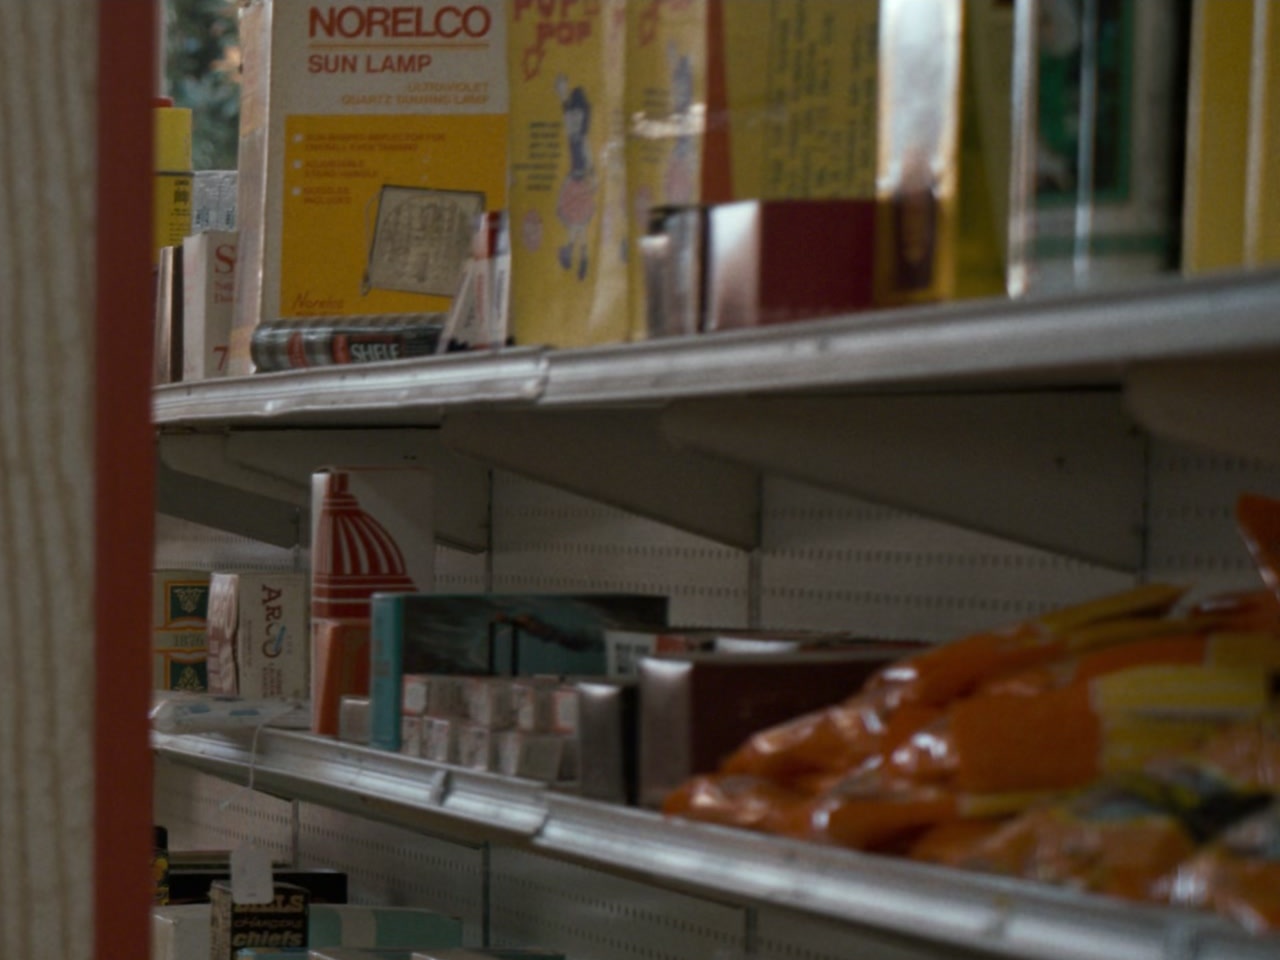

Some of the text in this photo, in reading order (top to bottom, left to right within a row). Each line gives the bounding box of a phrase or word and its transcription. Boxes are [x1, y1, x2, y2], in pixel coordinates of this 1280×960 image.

[308, 5, 492, 39] NORELCO
[307, 54, 433, 75] SUN LAMP
